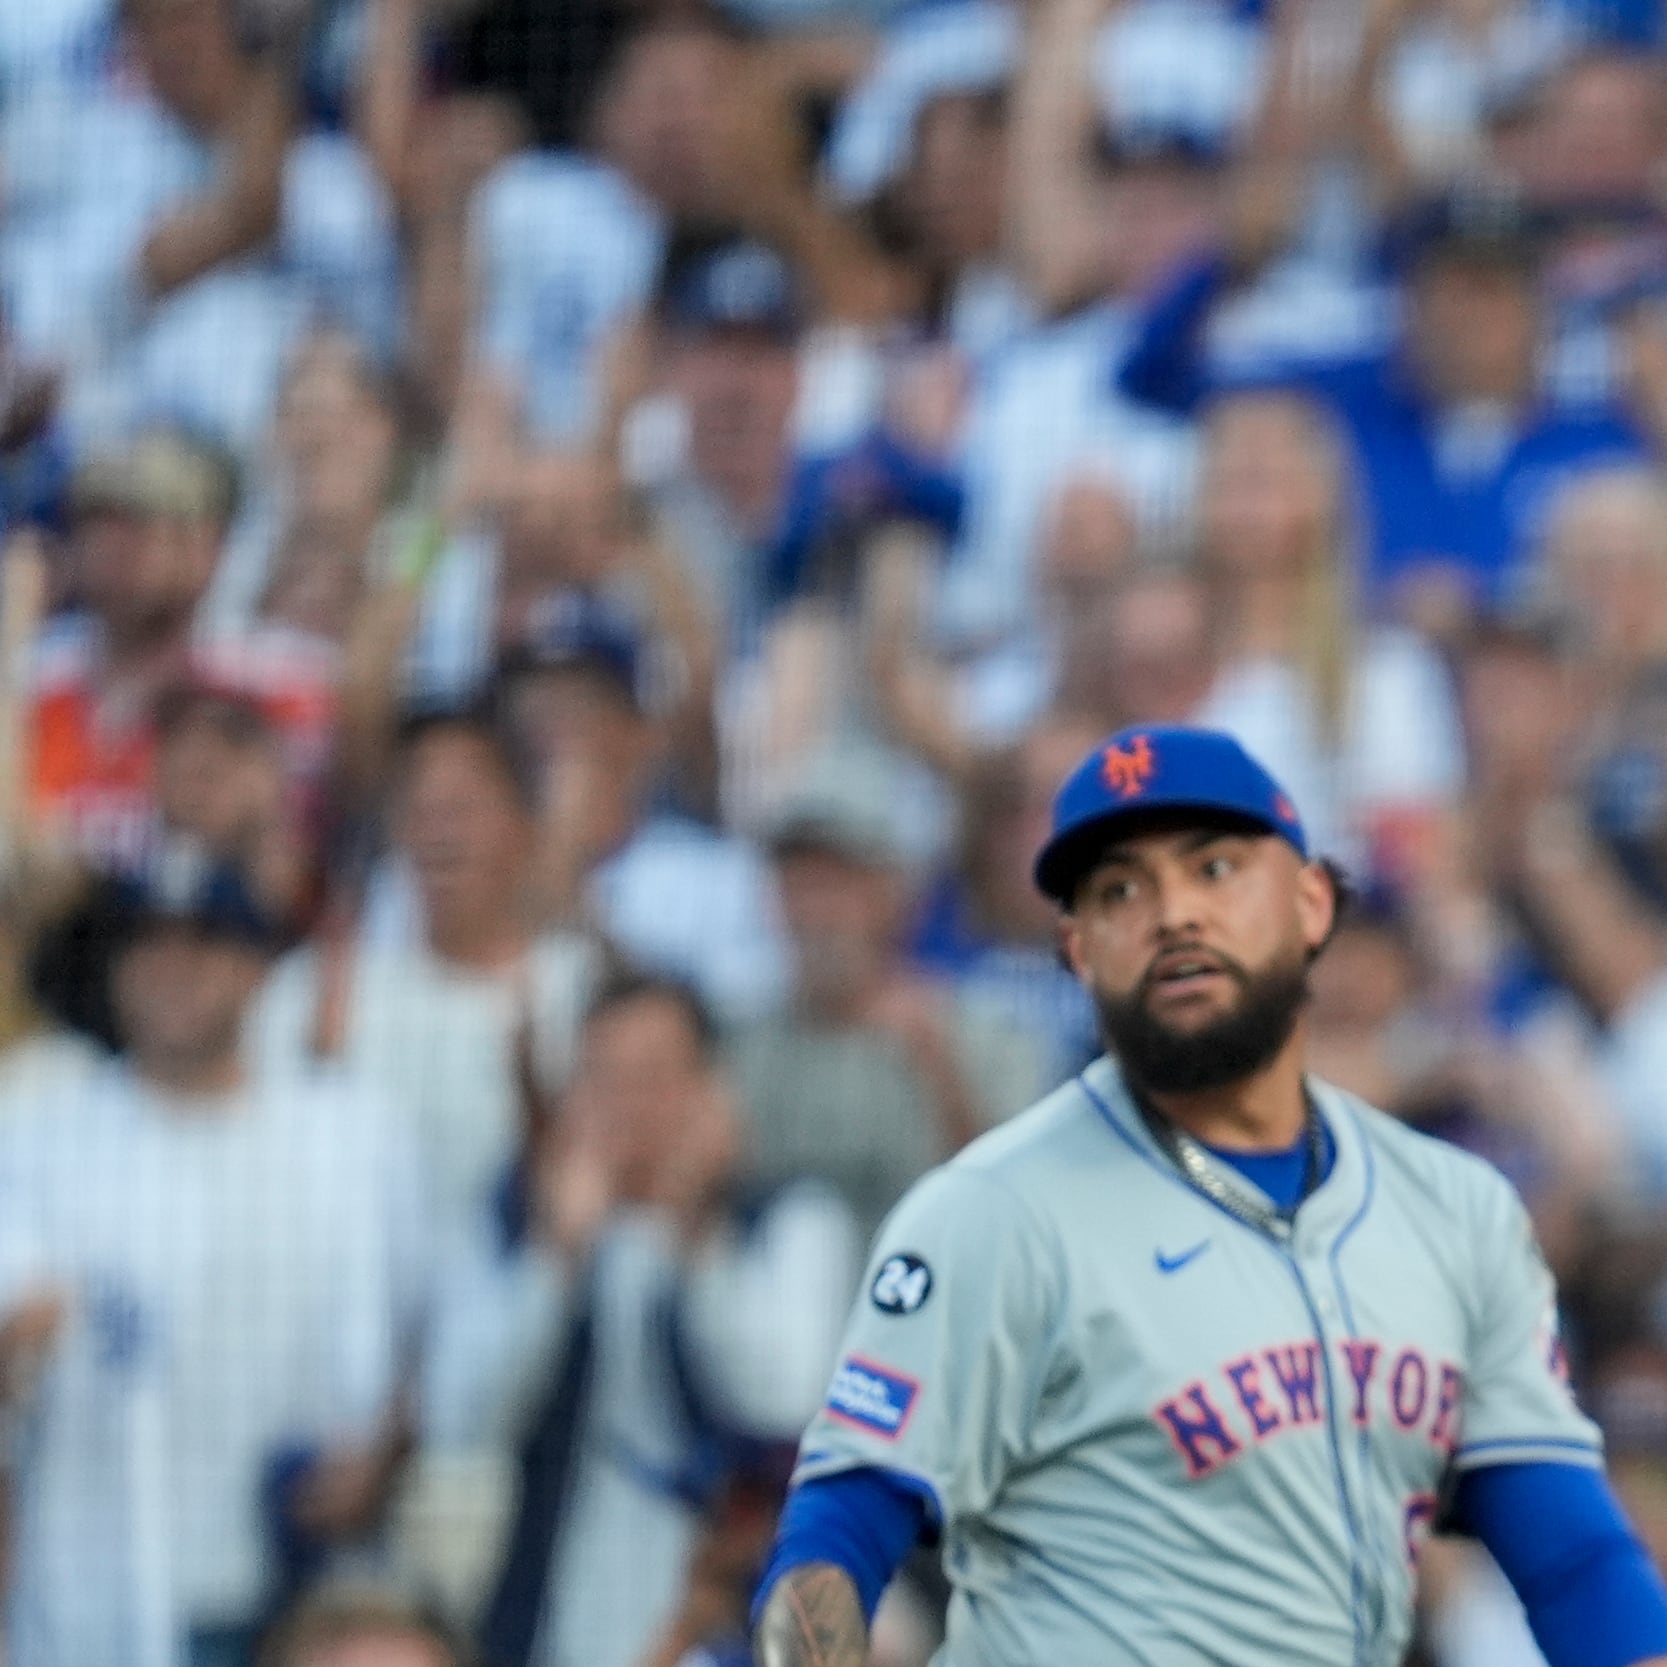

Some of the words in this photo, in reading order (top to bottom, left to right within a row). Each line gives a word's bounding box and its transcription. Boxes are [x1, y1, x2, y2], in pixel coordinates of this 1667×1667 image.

[874, 1257, 929, 1308] 24
[1153, 1340, 1325, 1480] NEW
[1338, 1339, 1464, 1453] YOR
